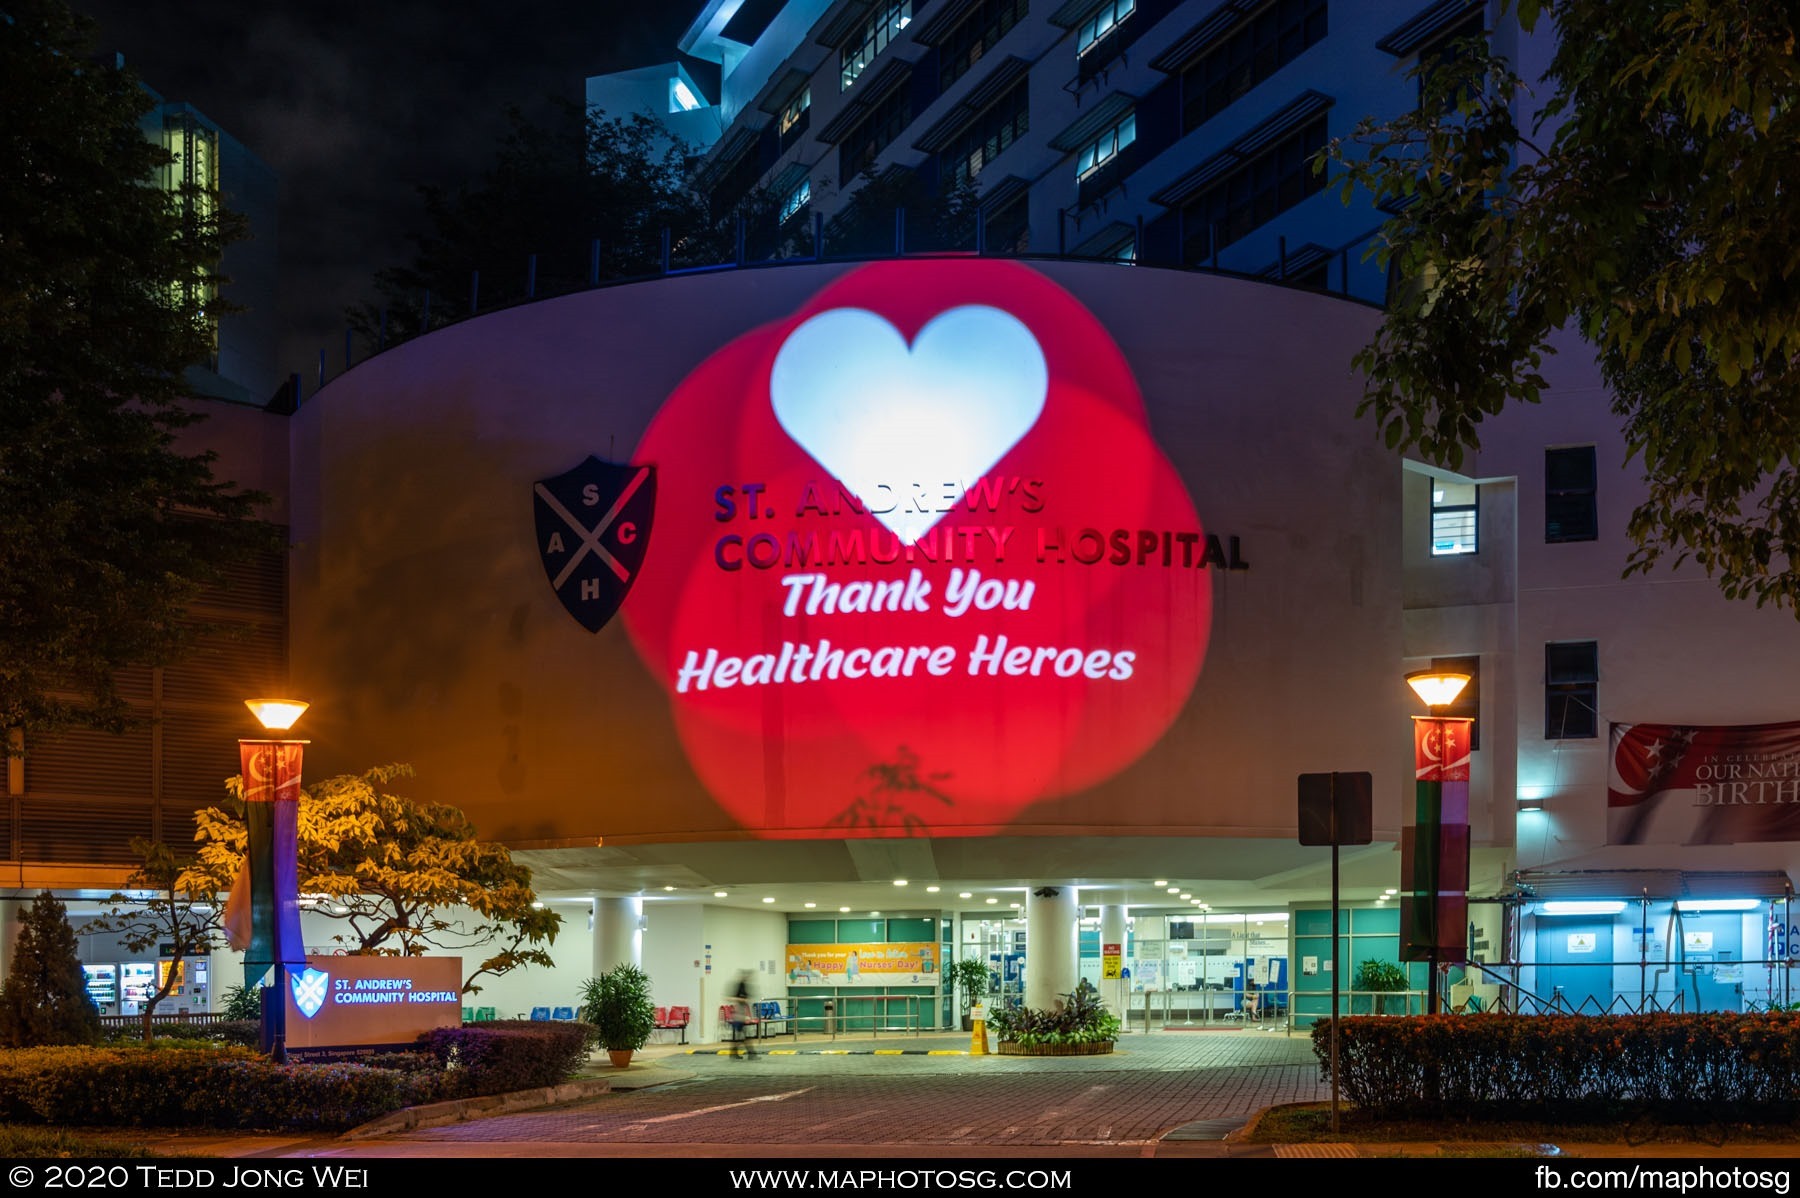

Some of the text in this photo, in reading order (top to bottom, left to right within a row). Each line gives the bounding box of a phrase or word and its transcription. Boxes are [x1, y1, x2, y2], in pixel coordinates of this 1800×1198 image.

[582, 484, 600, 506] S
[714, 476, 1044, 522] ST. ANDREW'S
[547, 532, 565, 554] A
[617, 522, 637, 545] C
[714, 526, 1249, 571] COMMUNITY HOSPITAL
[581, 578, 600, 601] H
[781, 567, 1036, 618] Thank You
[676, 634, 1136, 694] Healthcare Heroes
[1695, 764, 1742, 780] OUR
[1692, 780, 1800, 806] BIRTH
[813, 961, 844, 970] Happy
[335, 979, 412, 990] ST. ANDREW'S
[335, 991, 458, 1004] COMMUNITY HOSPITAL
